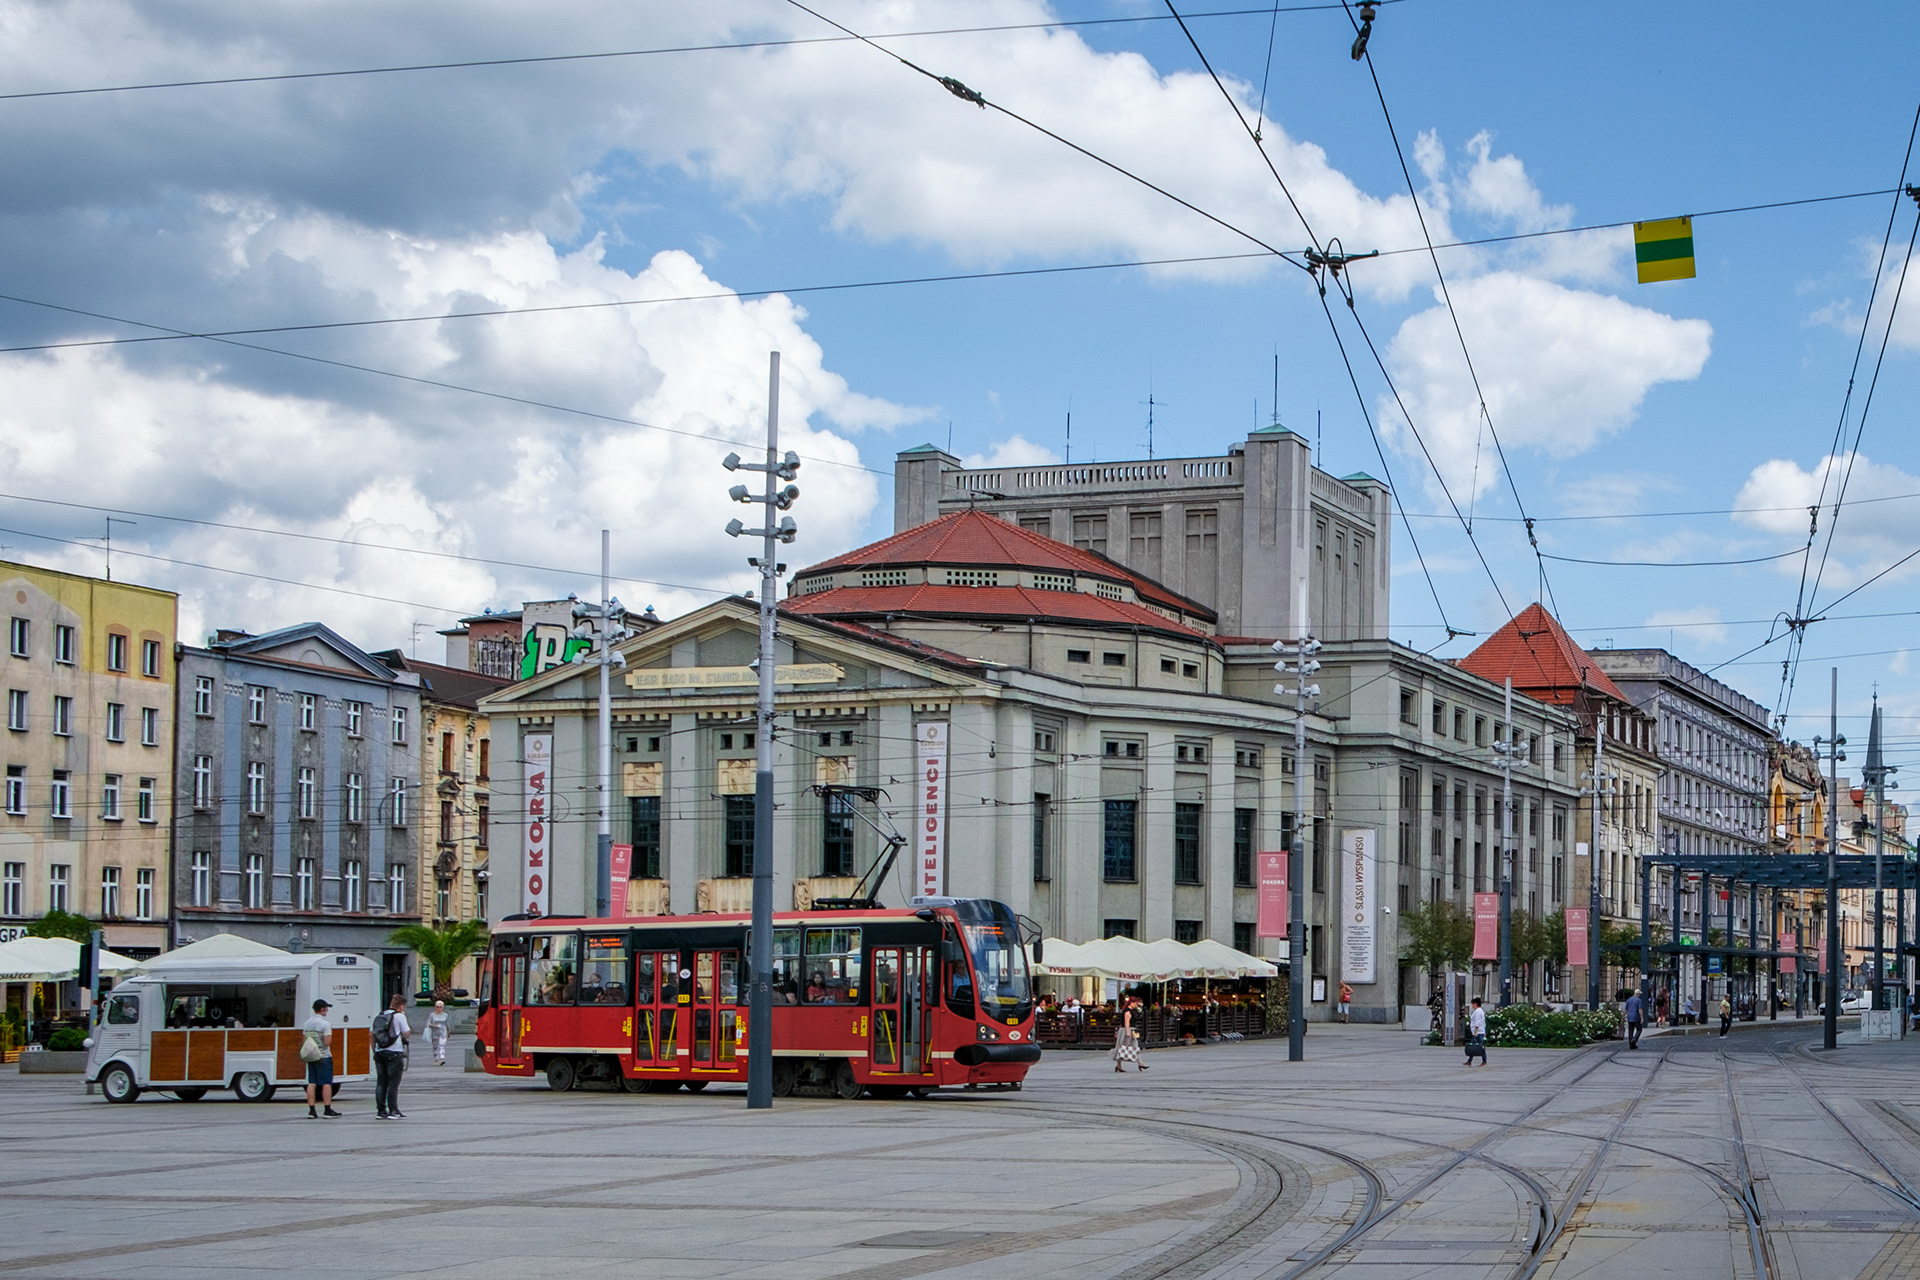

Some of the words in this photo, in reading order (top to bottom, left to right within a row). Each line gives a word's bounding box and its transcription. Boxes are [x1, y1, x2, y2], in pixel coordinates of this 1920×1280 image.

[528, 771, 546, 916] POKORA
[1048, 966, 1073, 974] TYSKIE
[1118, 971, 1142, 980] TYSKIE
